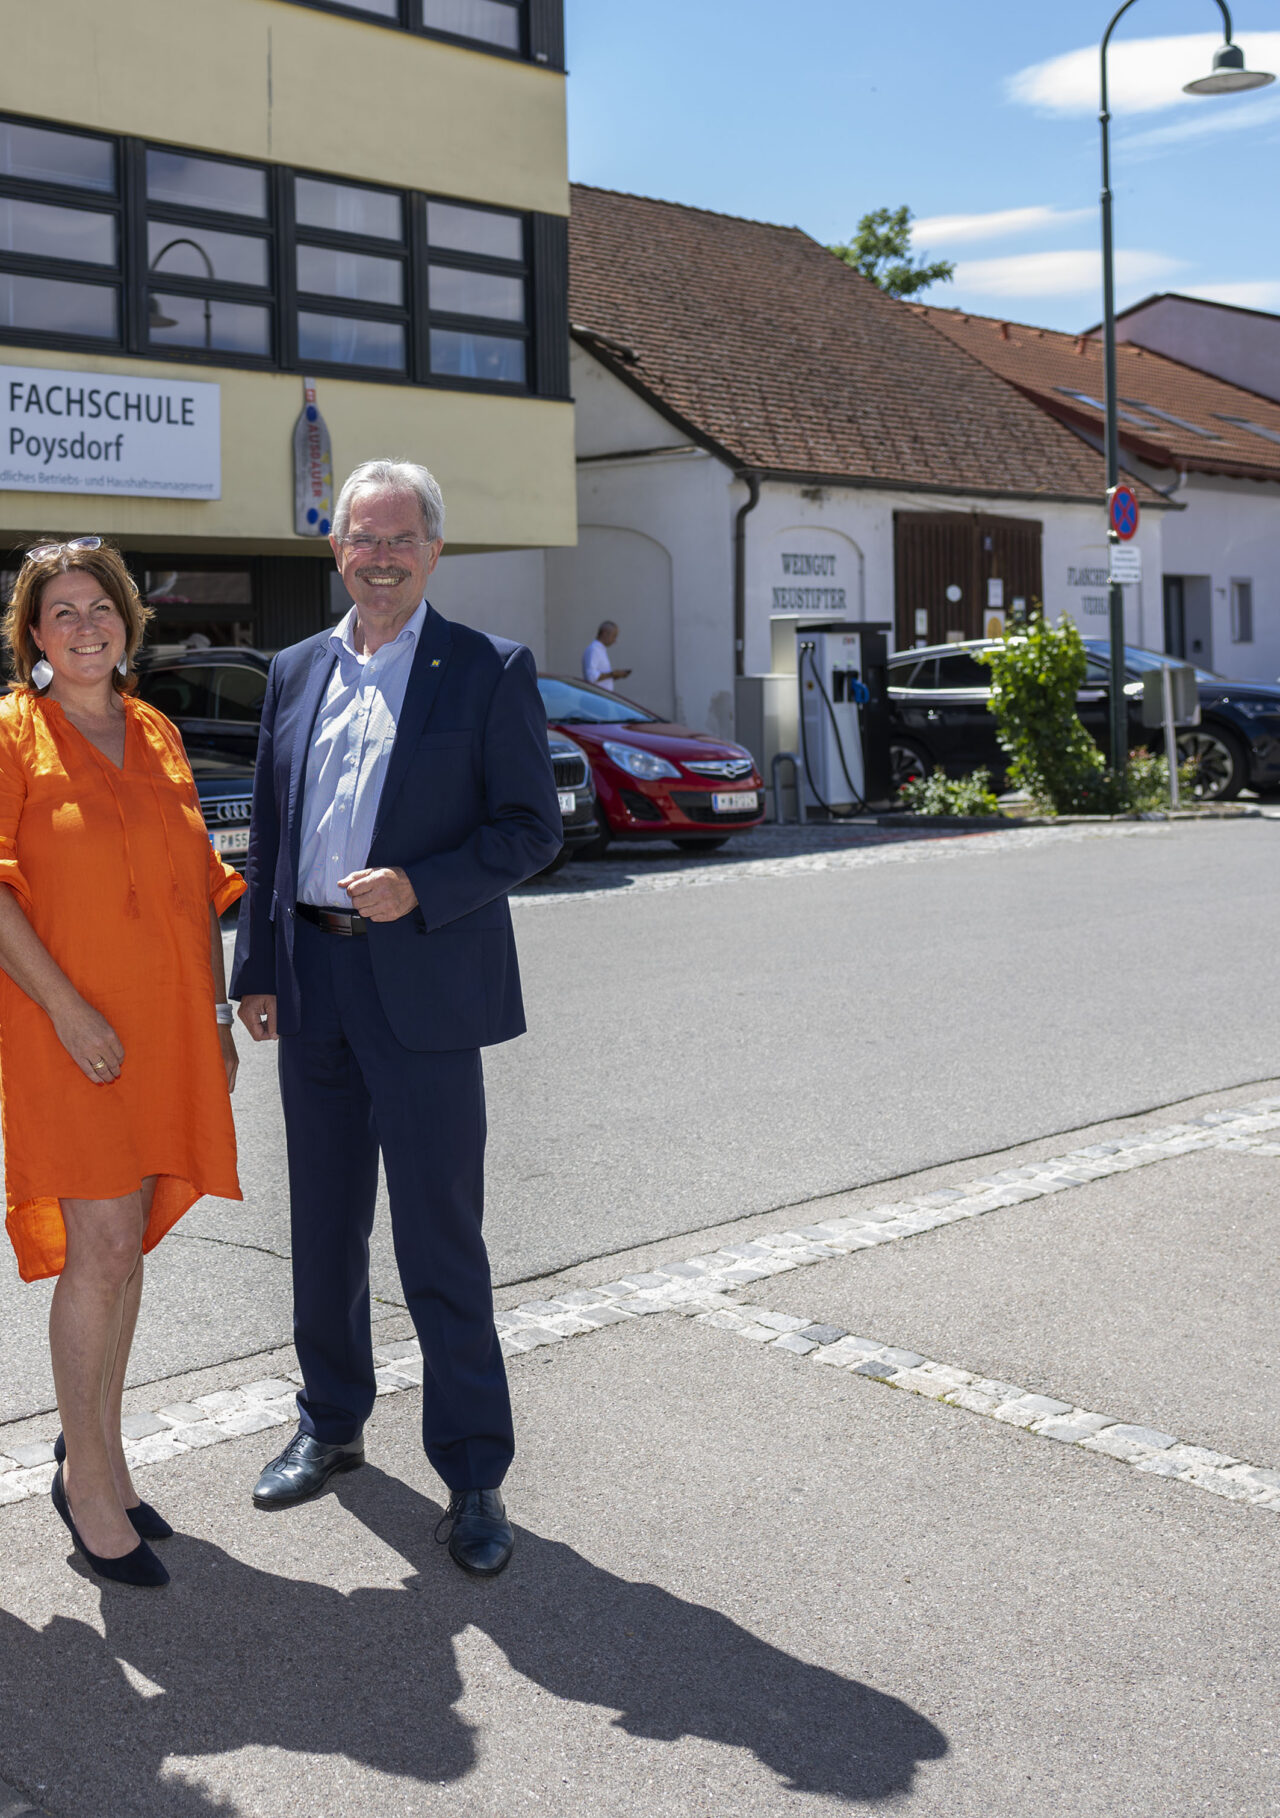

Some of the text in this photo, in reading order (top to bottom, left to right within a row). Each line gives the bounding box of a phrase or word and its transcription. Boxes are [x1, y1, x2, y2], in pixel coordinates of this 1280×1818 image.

[9, 381, 195, 426] FACHSCHULE
[9, 427, 124, 465] Poysdorf
[38, 472, 82, 486] Betriebs-
[84, 475, 105, 487] und
[106, 475, 214, 494] Haushaltsmanagement
[781, 552, 836, 577] WEINGUT
[771, 586, 847, 610] NEUSTIFTER
